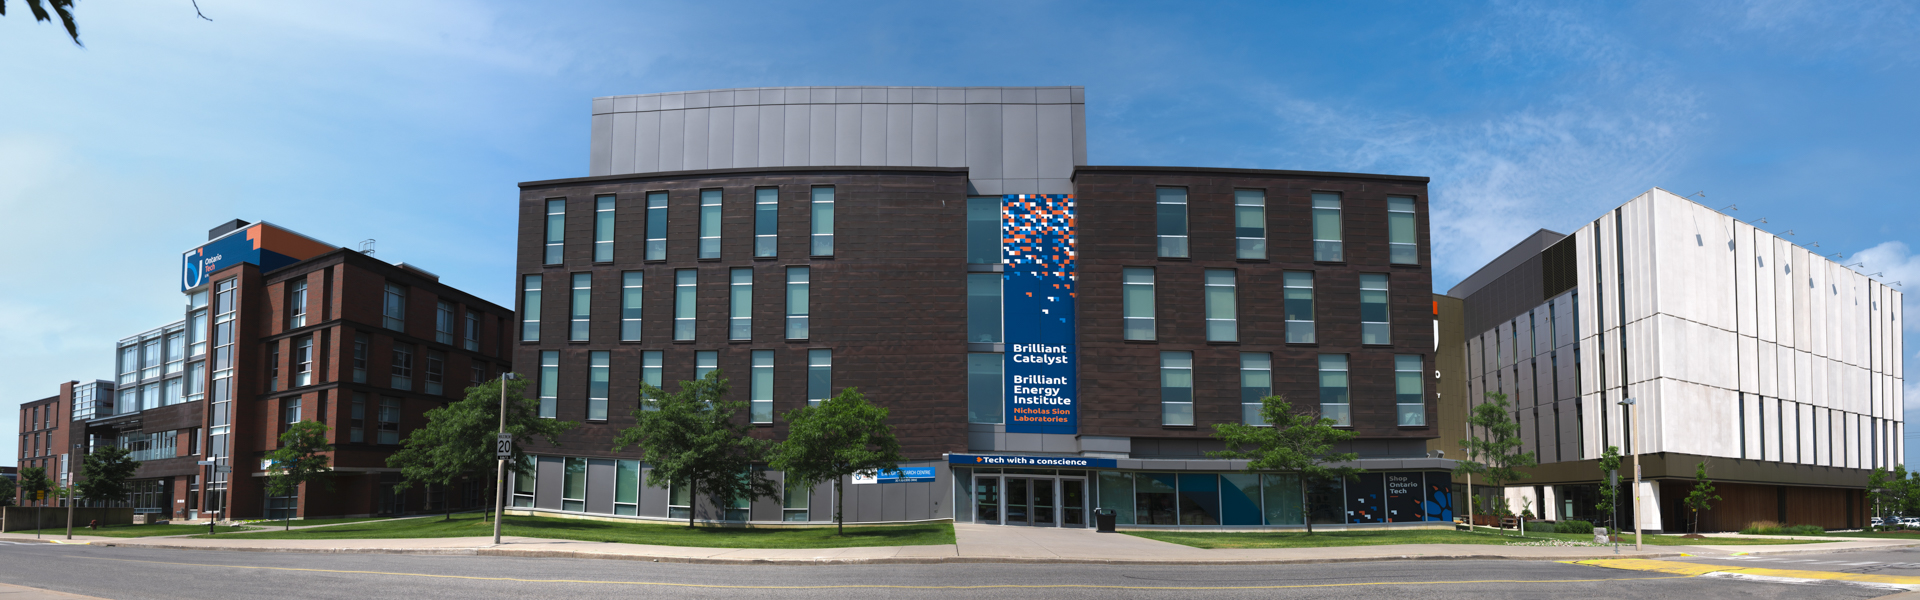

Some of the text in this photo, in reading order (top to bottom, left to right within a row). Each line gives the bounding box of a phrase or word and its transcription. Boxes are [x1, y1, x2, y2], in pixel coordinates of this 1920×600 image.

[204, 253, 222, 266] Ontario
[205, 263, 216, 272] Tech
[1013, 344, 1067, 354] Brilliant
[1013, 354, 1068, 366] Catalyst
[1014, 374, 1068, 385] Brilliant
[1014, 385, 1060, 396] Energy
[1014, 395, 1071, 405] Institute
[498, 440, 510, 453] 20
